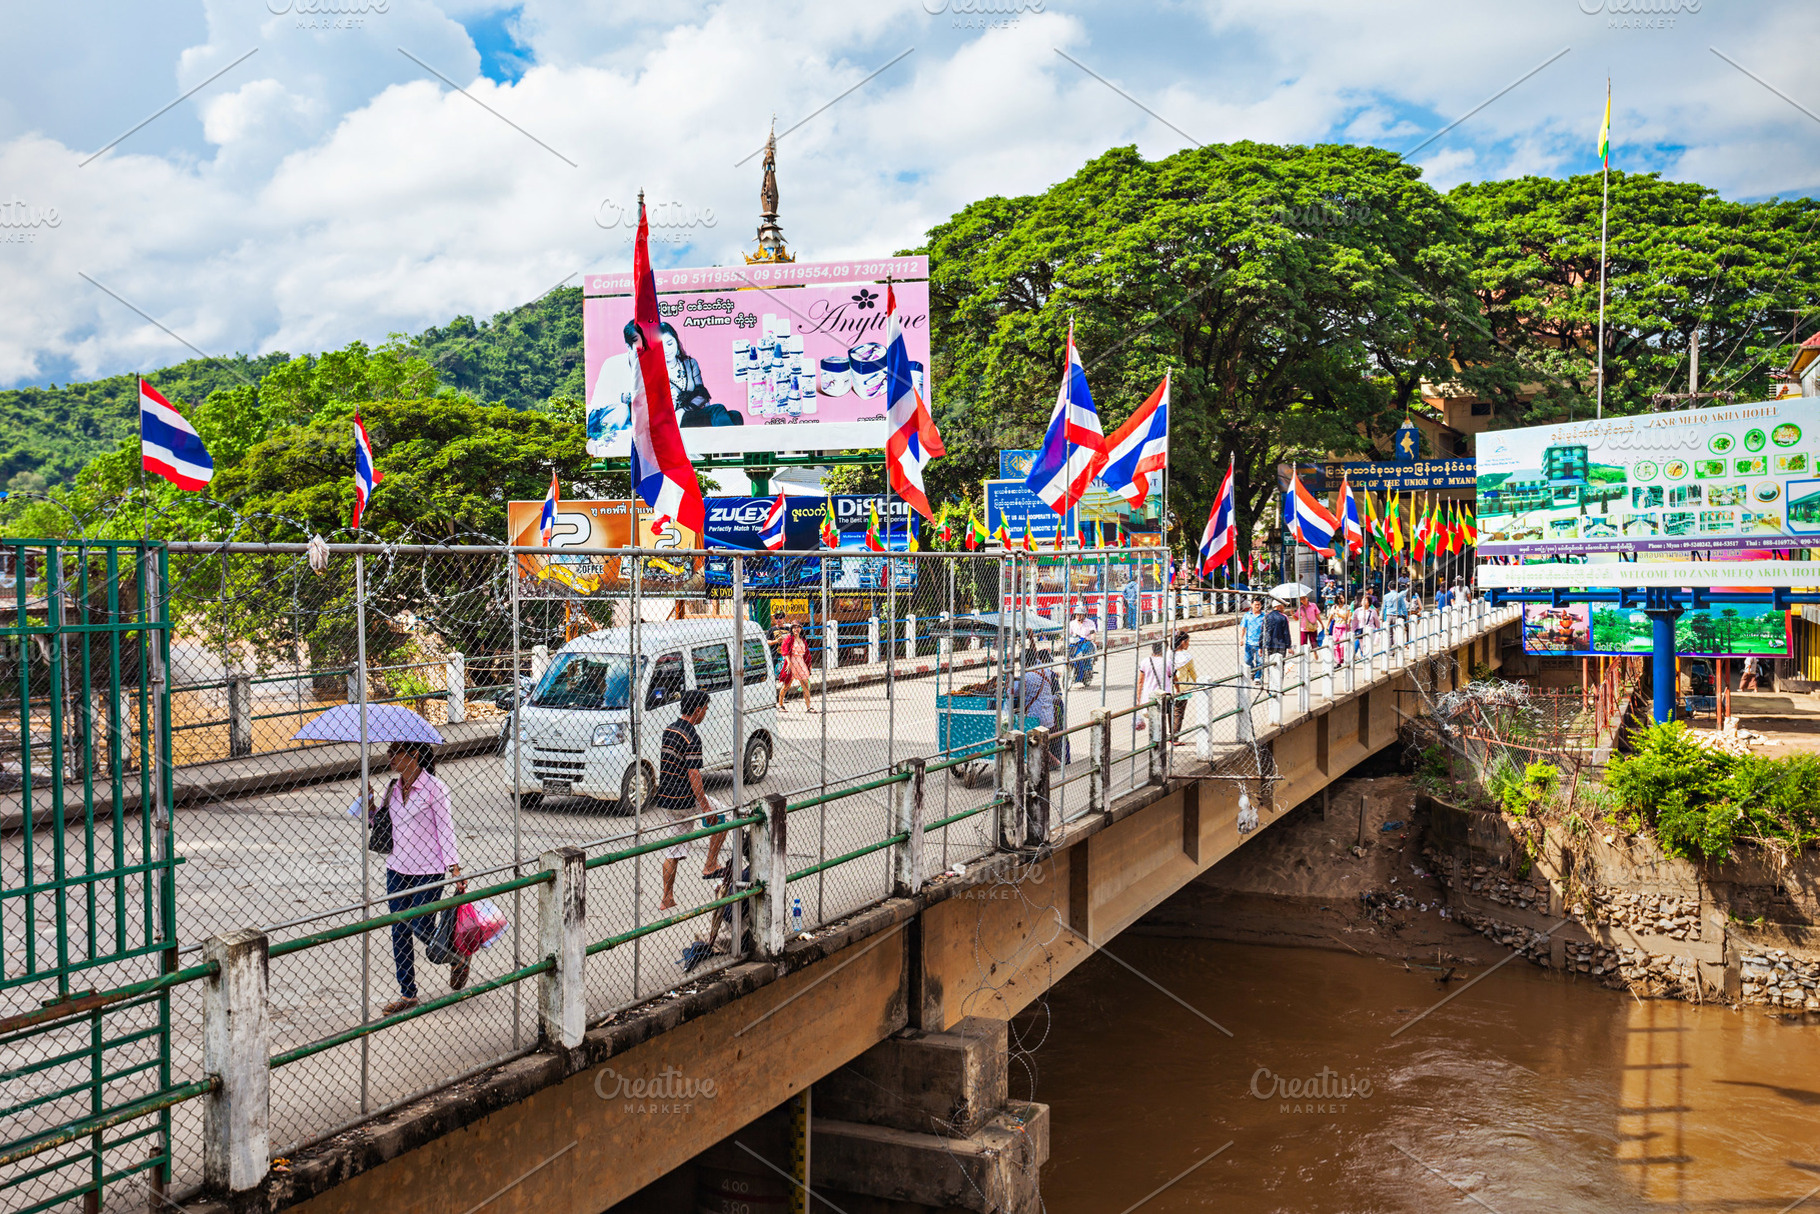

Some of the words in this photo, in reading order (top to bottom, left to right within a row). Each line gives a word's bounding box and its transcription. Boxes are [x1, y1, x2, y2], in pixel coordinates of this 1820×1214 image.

[672, 274, 688, 285] 09
[754, 269, 770, 281] 09
[774, 265, 849, 280] 5119554,09
[854, 261, 918, 275] 73073112
[684, 315, 731, 328] Anytime
[1743, 406, 1779, 418] HOTEL
[1368, 480, 1379, 488] OF
[1383, 479, 1400, 487] THE
[1404, 478, 1429, 487] UNION
[1433, 477, 1444, 486] OF
[709, 507, 772, 522] ZULEX
[708, 525, 733, 533] Perfectly
[733, 524, 750, 532] Match
[1620, 569, 1669, 579] WELCOME
[1673, 569, 1686, 578] TO
[1690, 568, 1718, 578] ZANR
[1757, 567, 1788, 577] AKHA
[1594, 641, 1613, 651] Golf
[721, 1179, 749, 1193] 400
